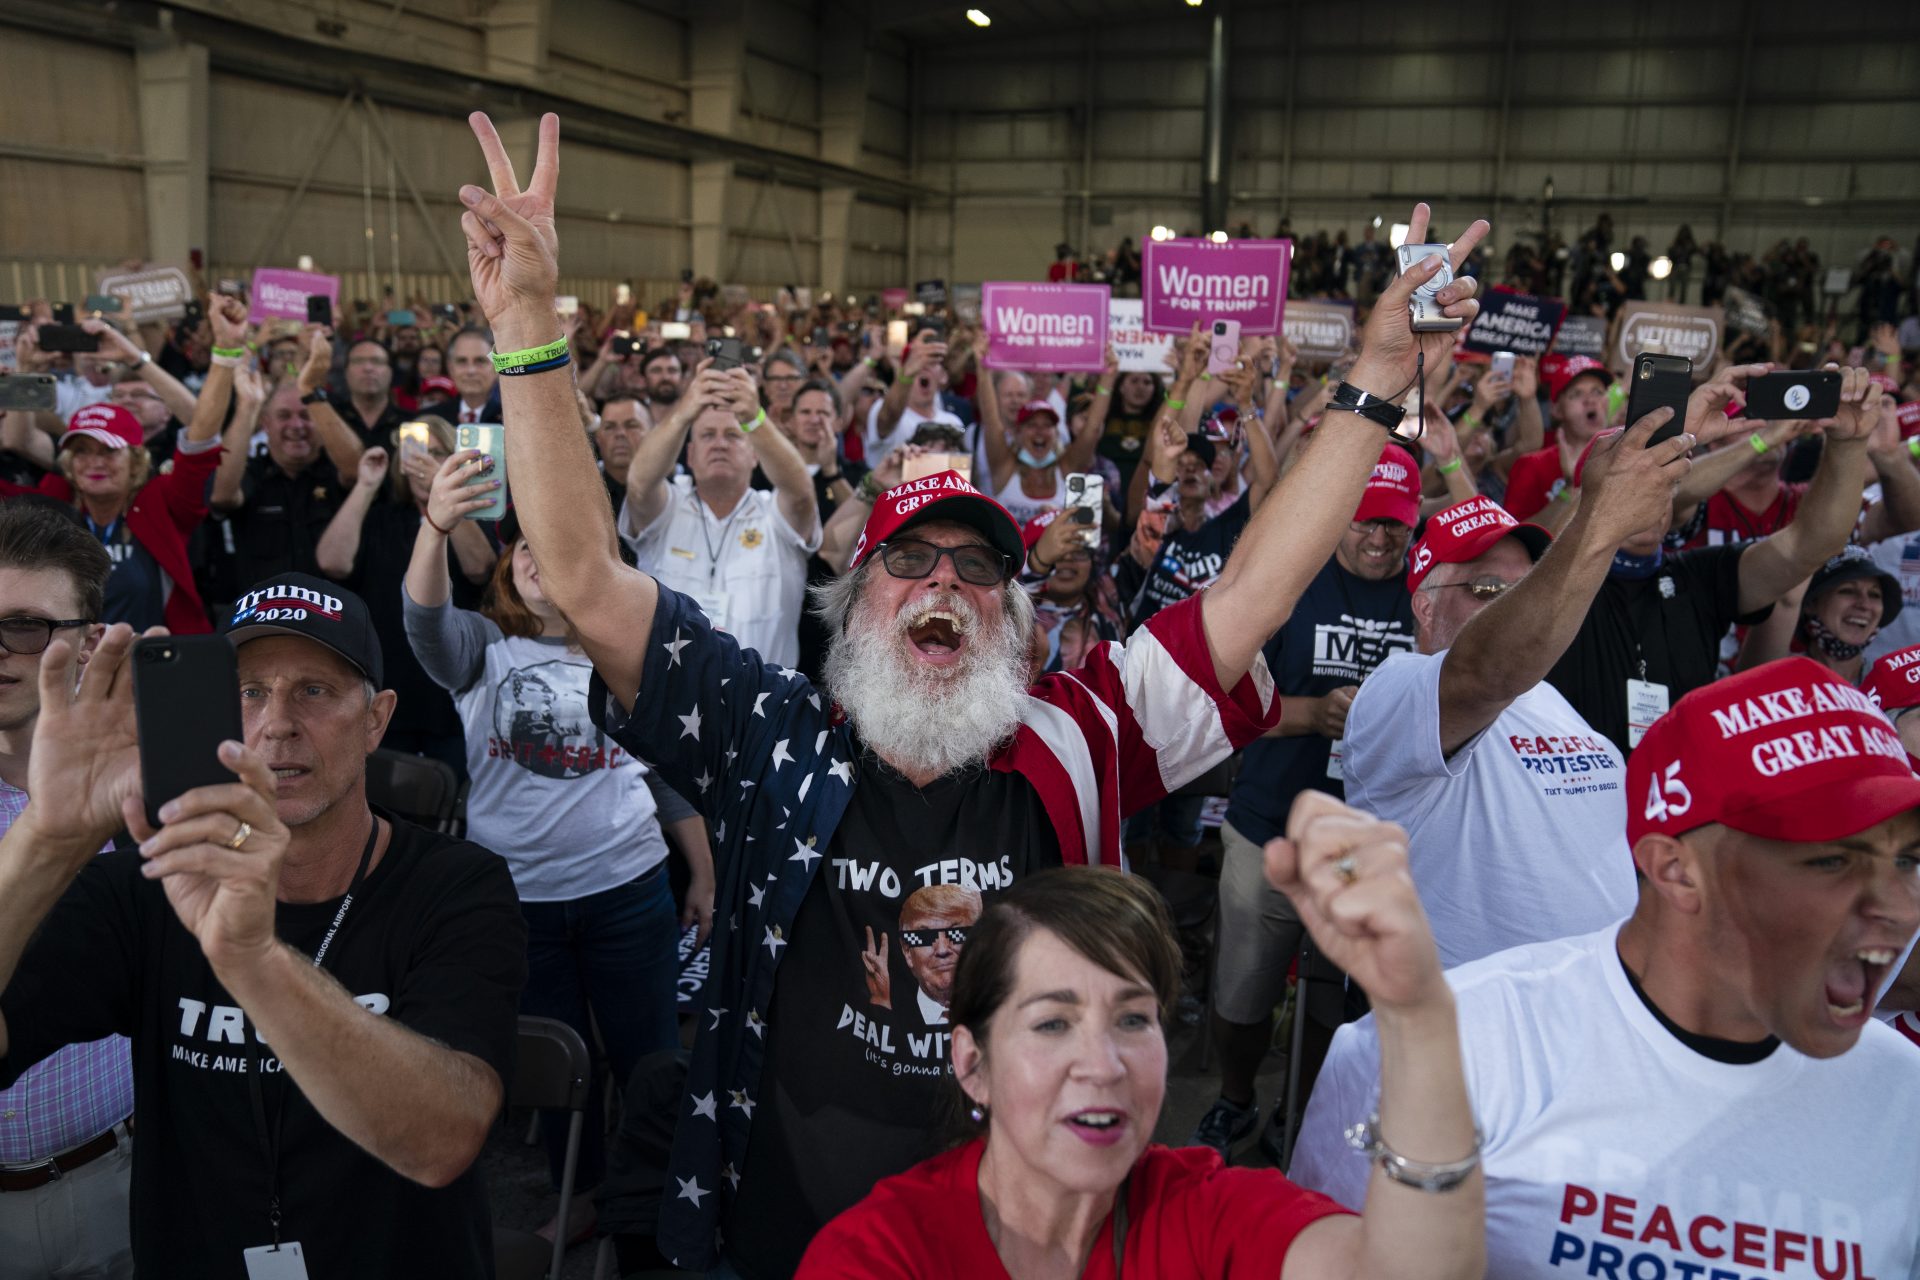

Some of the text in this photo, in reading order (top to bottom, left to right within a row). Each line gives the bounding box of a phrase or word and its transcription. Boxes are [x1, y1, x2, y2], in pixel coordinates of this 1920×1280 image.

[1159, 264, 1269, 298] Women
[1171, 297, 1258, 312] FOR TRUMP
[1503, 302, 1539, 319] MAKE
[997, 306, 1094, 336] Women
[1475, 311, 1552, 340] AMERICA
[1007, 334, 1085, 347] FOR TRUMP
[1470, 327, 1511, 347] GREAT
[505, 366, 526, 374] BLUE
[514, 351, 541, 365] TEXT
[885, 477, 940, 500] MAKE
[1436, 502, 1479, 526] MAKE
[1451, 512, 1497, 537] GREAT
[1413, 541, 1432, 575] 45
[236, 584, 343, 615] Trump
[254, 607, 308, 622] 2020
[1711, 686, 1814, 739] MAKE
[489, 737, 535, 766] GRIT
[562, 743, 626, 770] GRAC
[1521, 753, 1618, 775] PROTESTER
[1751, 725, 1860, 778] GREAT
[1544, 787, 1562, 796] TEXT
[1587, 784, 1598, 793] TO
[1599, 782, 1618, 791] 88022
[1645, 759, 1692, 823] 45
[832, 854, 1014, 899] TWO TERMS
[313, 893, 354, 968] REGIONAL AIRPORT
[837, 1003, 896, 1054] DEAL
[172, 1044, 286, 1075] MAKE AMEICA
[892, 1062, 940, 1076] gonna
[1559, 1182, 1876, 1280] PEACEFUL
